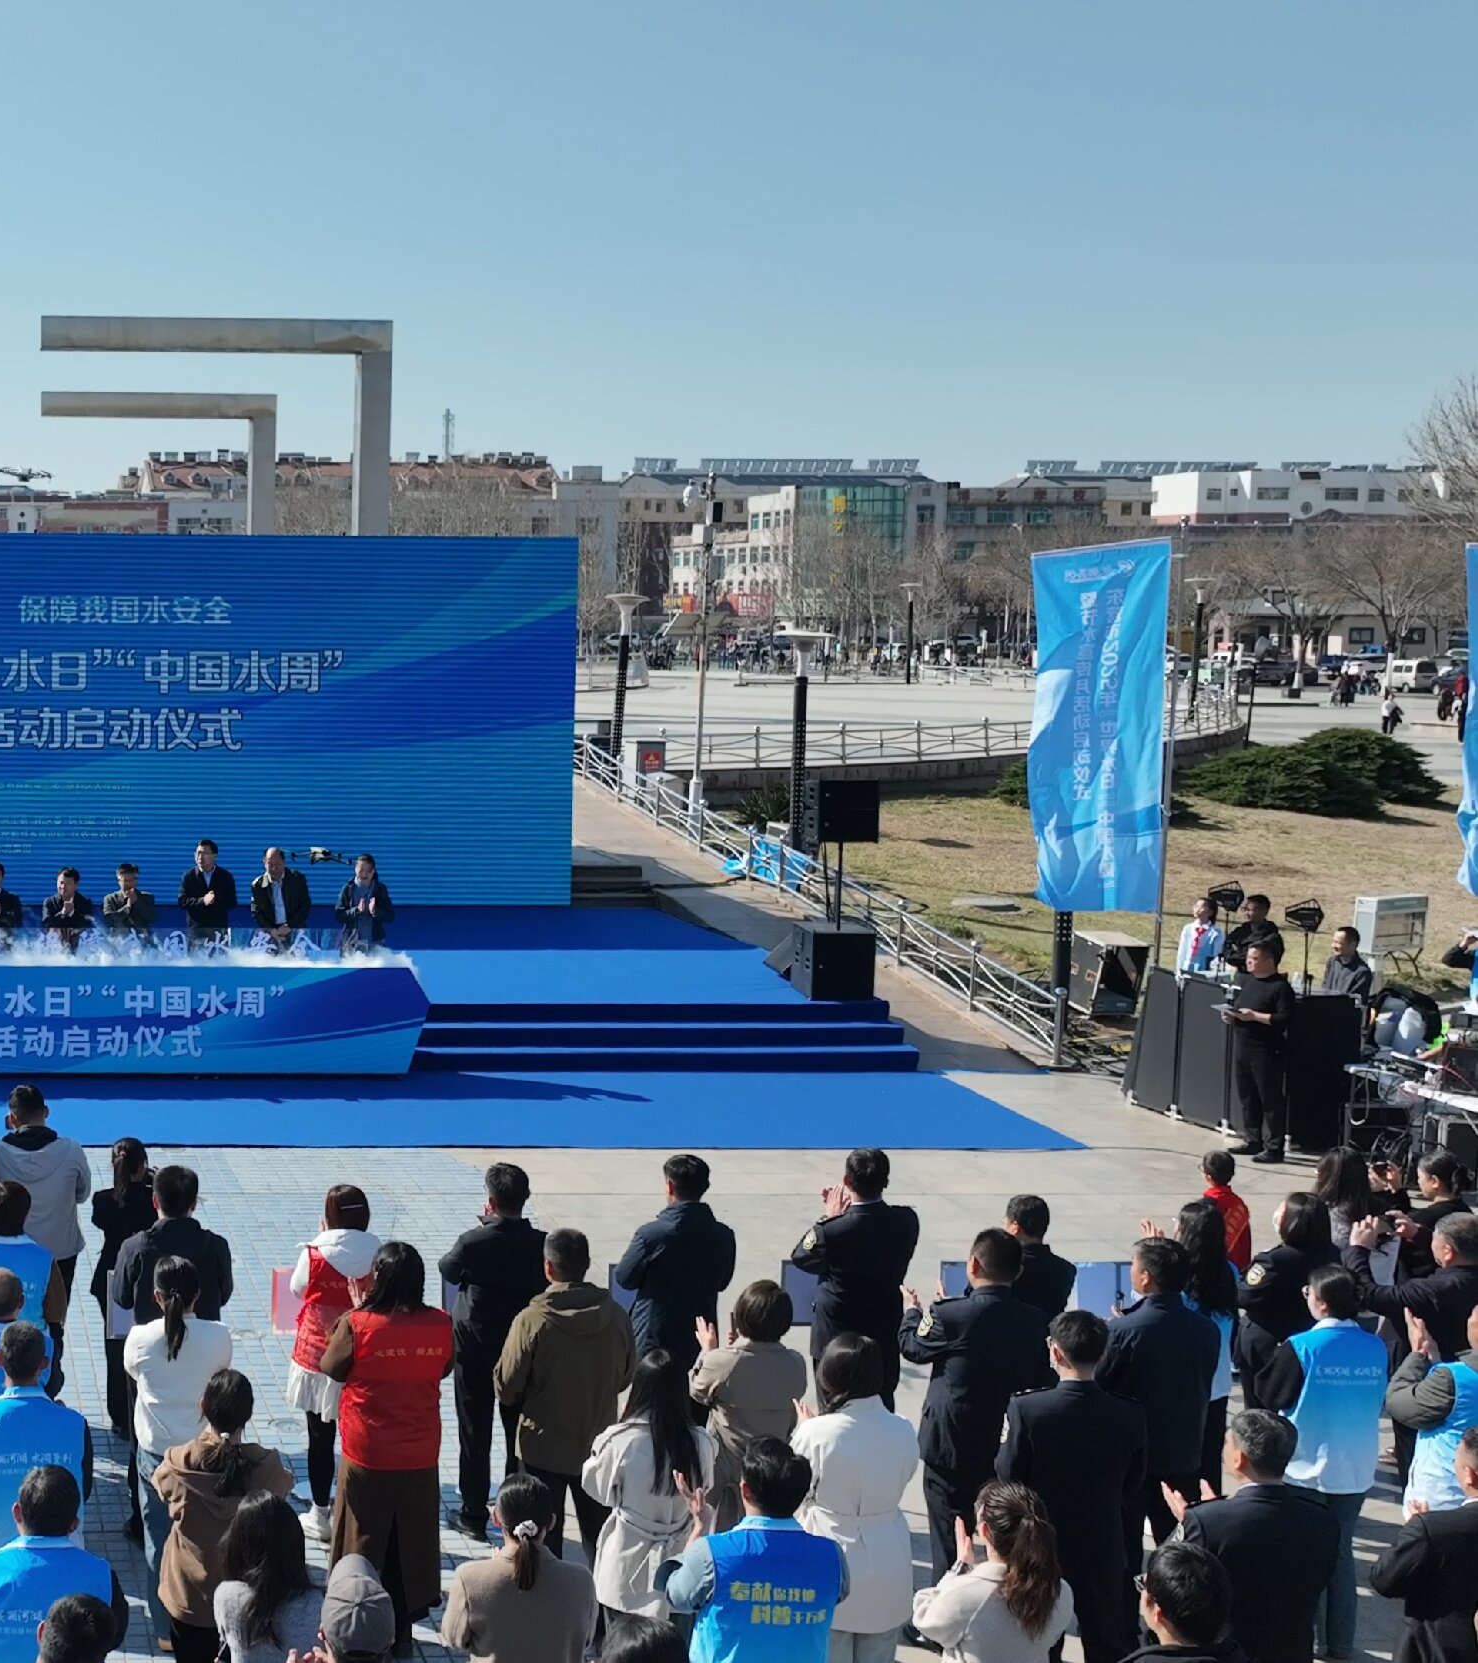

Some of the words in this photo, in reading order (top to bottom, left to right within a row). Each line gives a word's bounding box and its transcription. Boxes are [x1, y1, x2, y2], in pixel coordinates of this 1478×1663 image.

[18, 594, 233, 625] 保障我国水安全
